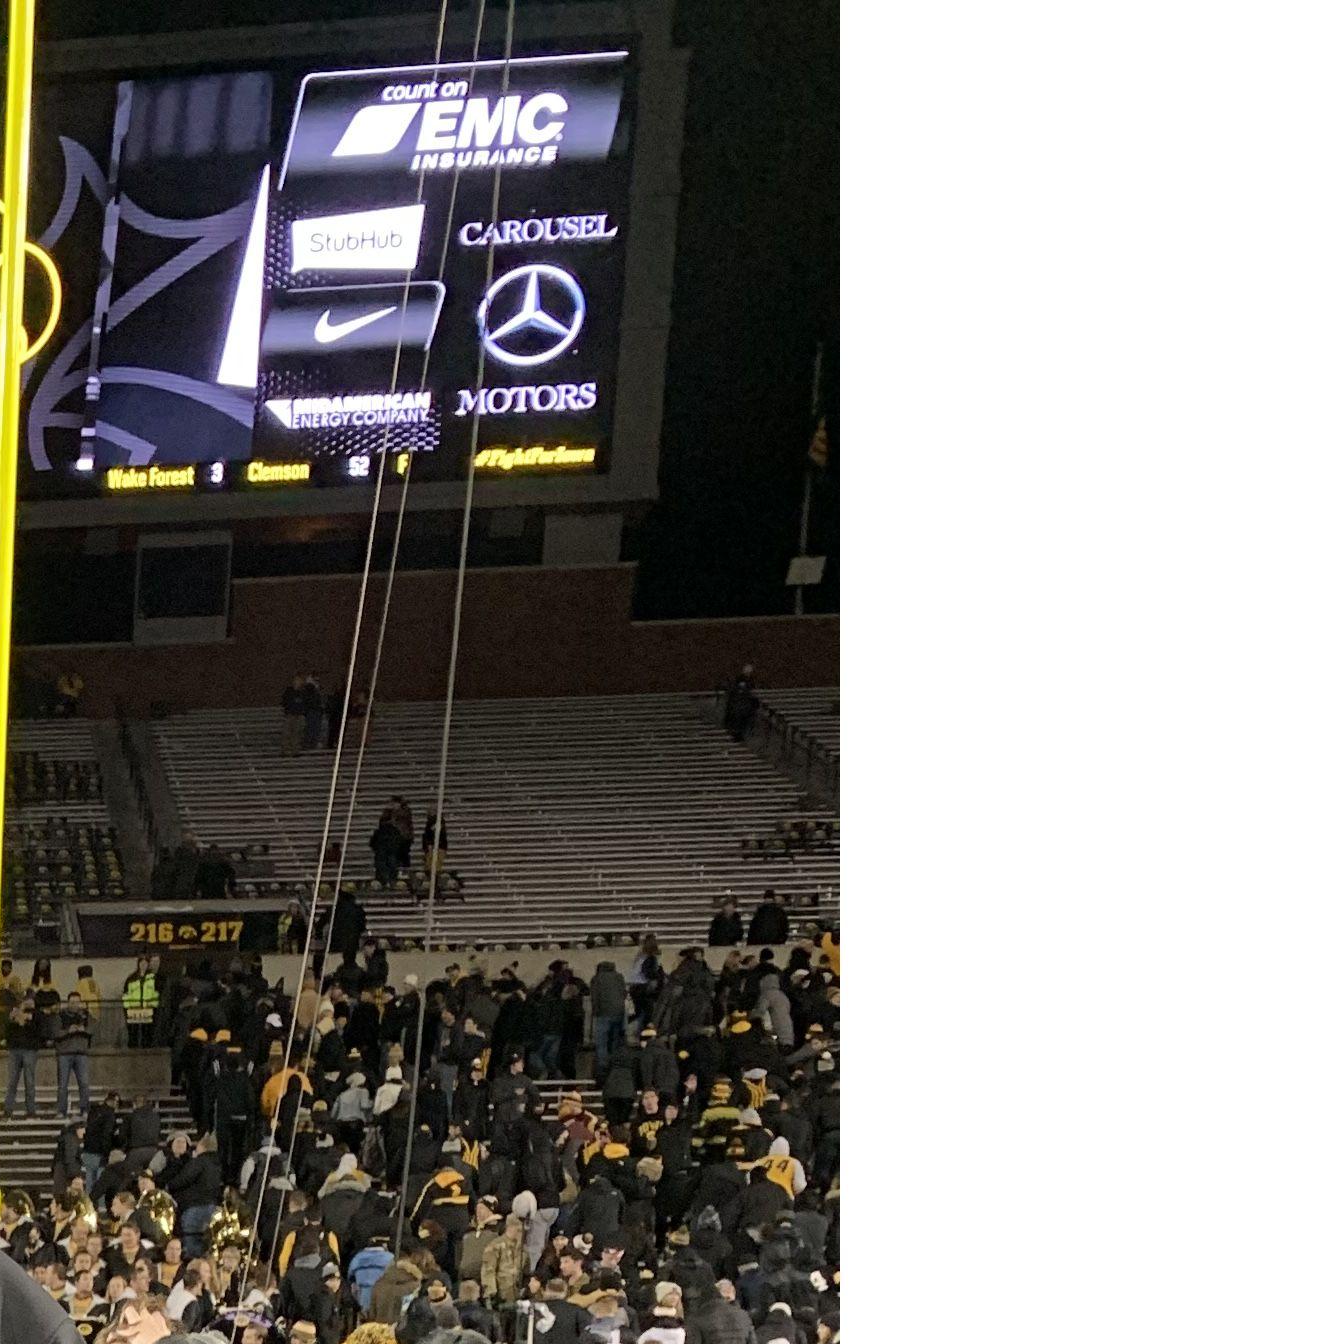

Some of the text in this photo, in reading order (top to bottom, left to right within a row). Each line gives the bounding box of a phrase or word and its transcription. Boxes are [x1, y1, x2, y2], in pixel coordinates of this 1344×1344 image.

[382, 81, 468, 101] count on
[415, 93, 569, 150] EMC
[411, 145, 558, 170] INSURANCE
[310, 231, 402, 252] StubHub
[458, 213, 618, 246] CAROUSEL
[455, 383, 596, 416] MOTORS
[293, 409, 429, 428] ENERGY COMPANY
[107, 469, 147, 489] Wake
[149, 466, 195, 487] Forest
[211, 462, 223, 484] 3
[247, 461, 310, 482] Clemson
[130, 921, 244, 943] 216 217
